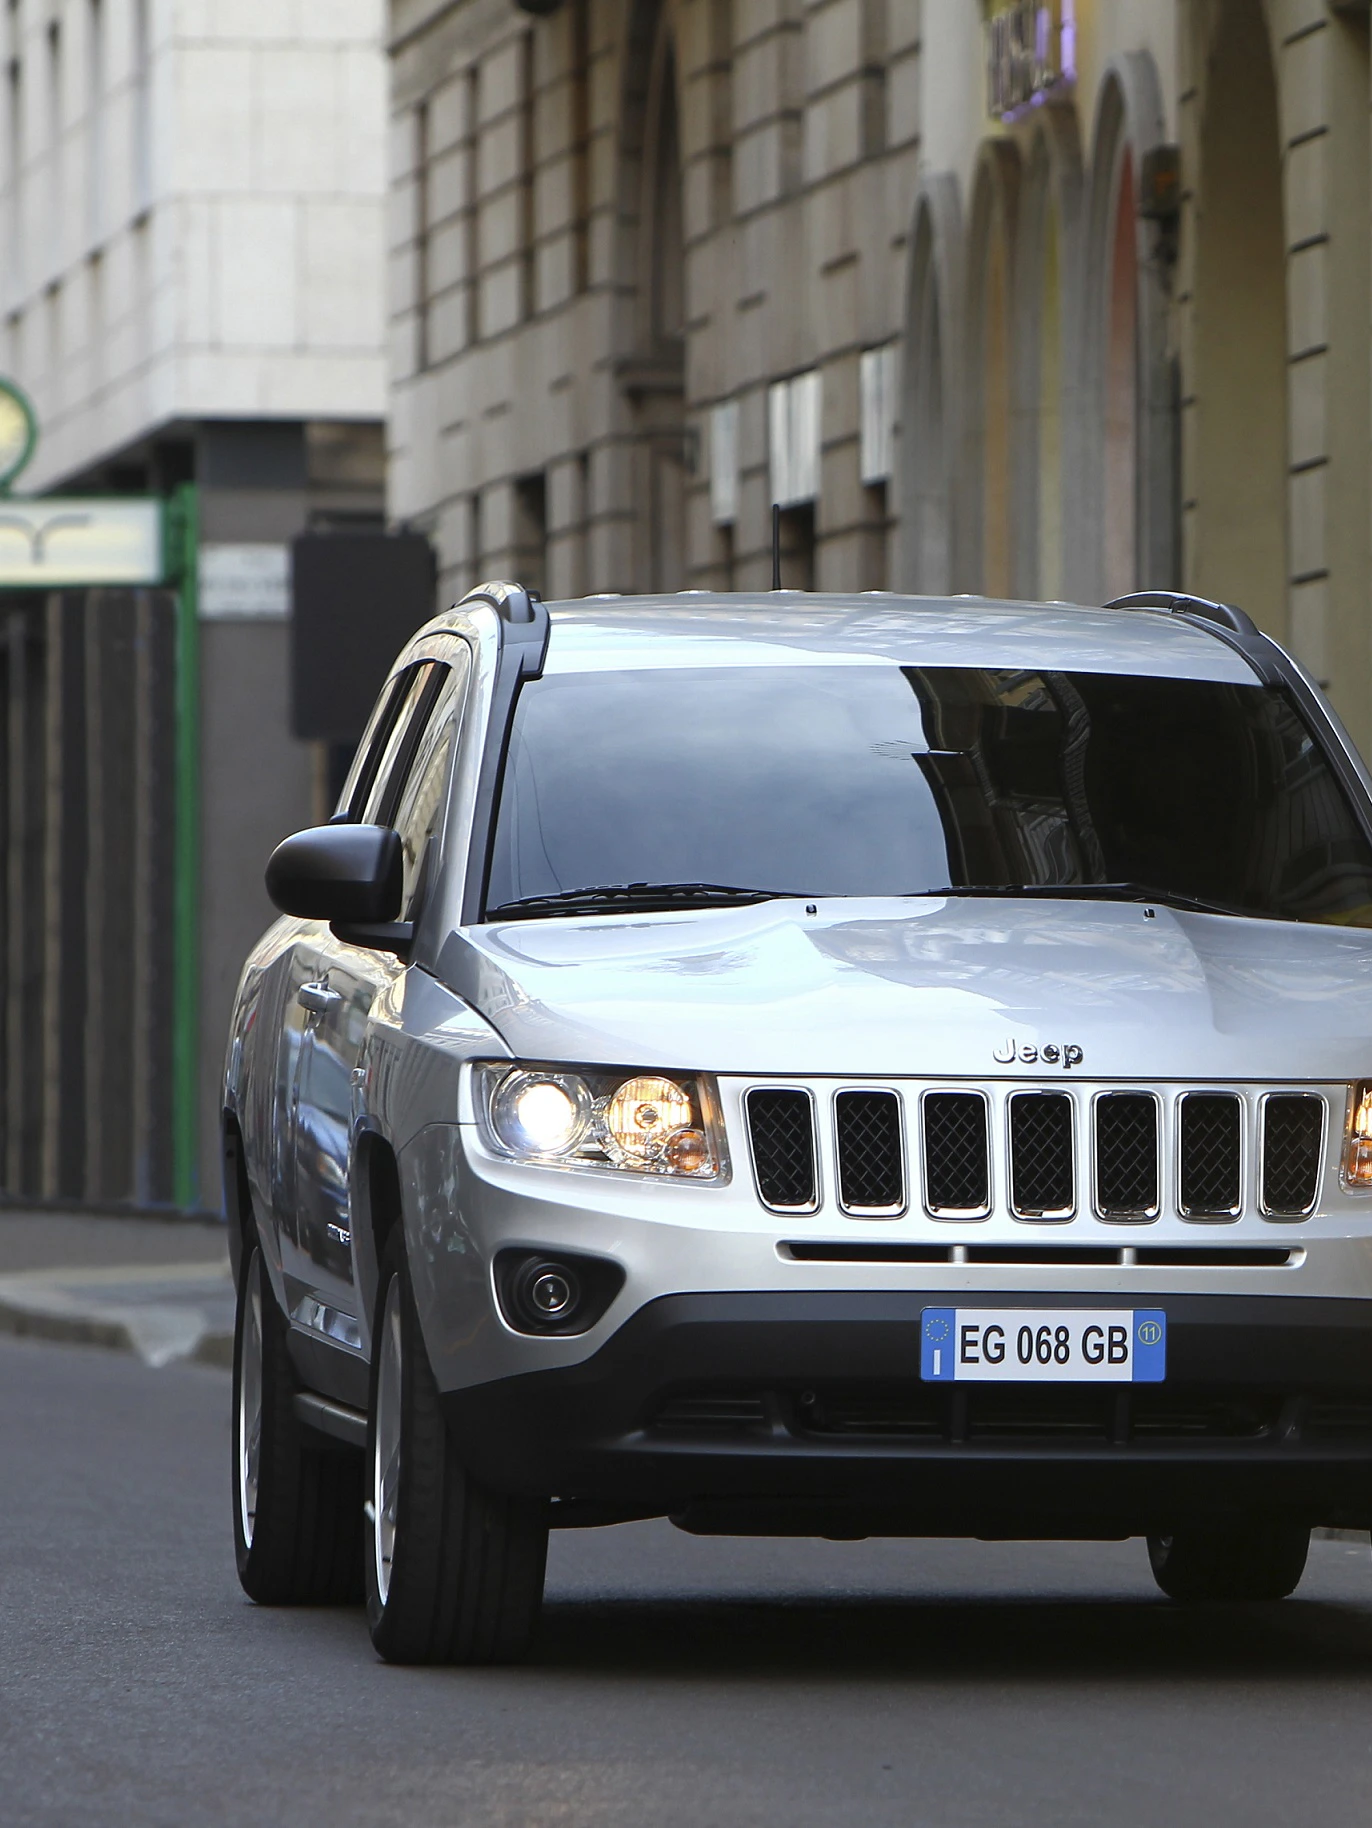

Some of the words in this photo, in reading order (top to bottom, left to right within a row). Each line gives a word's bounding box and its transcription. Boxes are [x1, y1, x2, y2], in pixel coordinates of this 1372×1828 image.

[993, 1038, 1084, 1069] Jeep
[960, 1325, 1006, 1364] EG
[1017, 1325, 1070, 1364] 068
[1082, 1325, 1129, 1364] GB
[1142, 1327, 1156, 1341] 11
